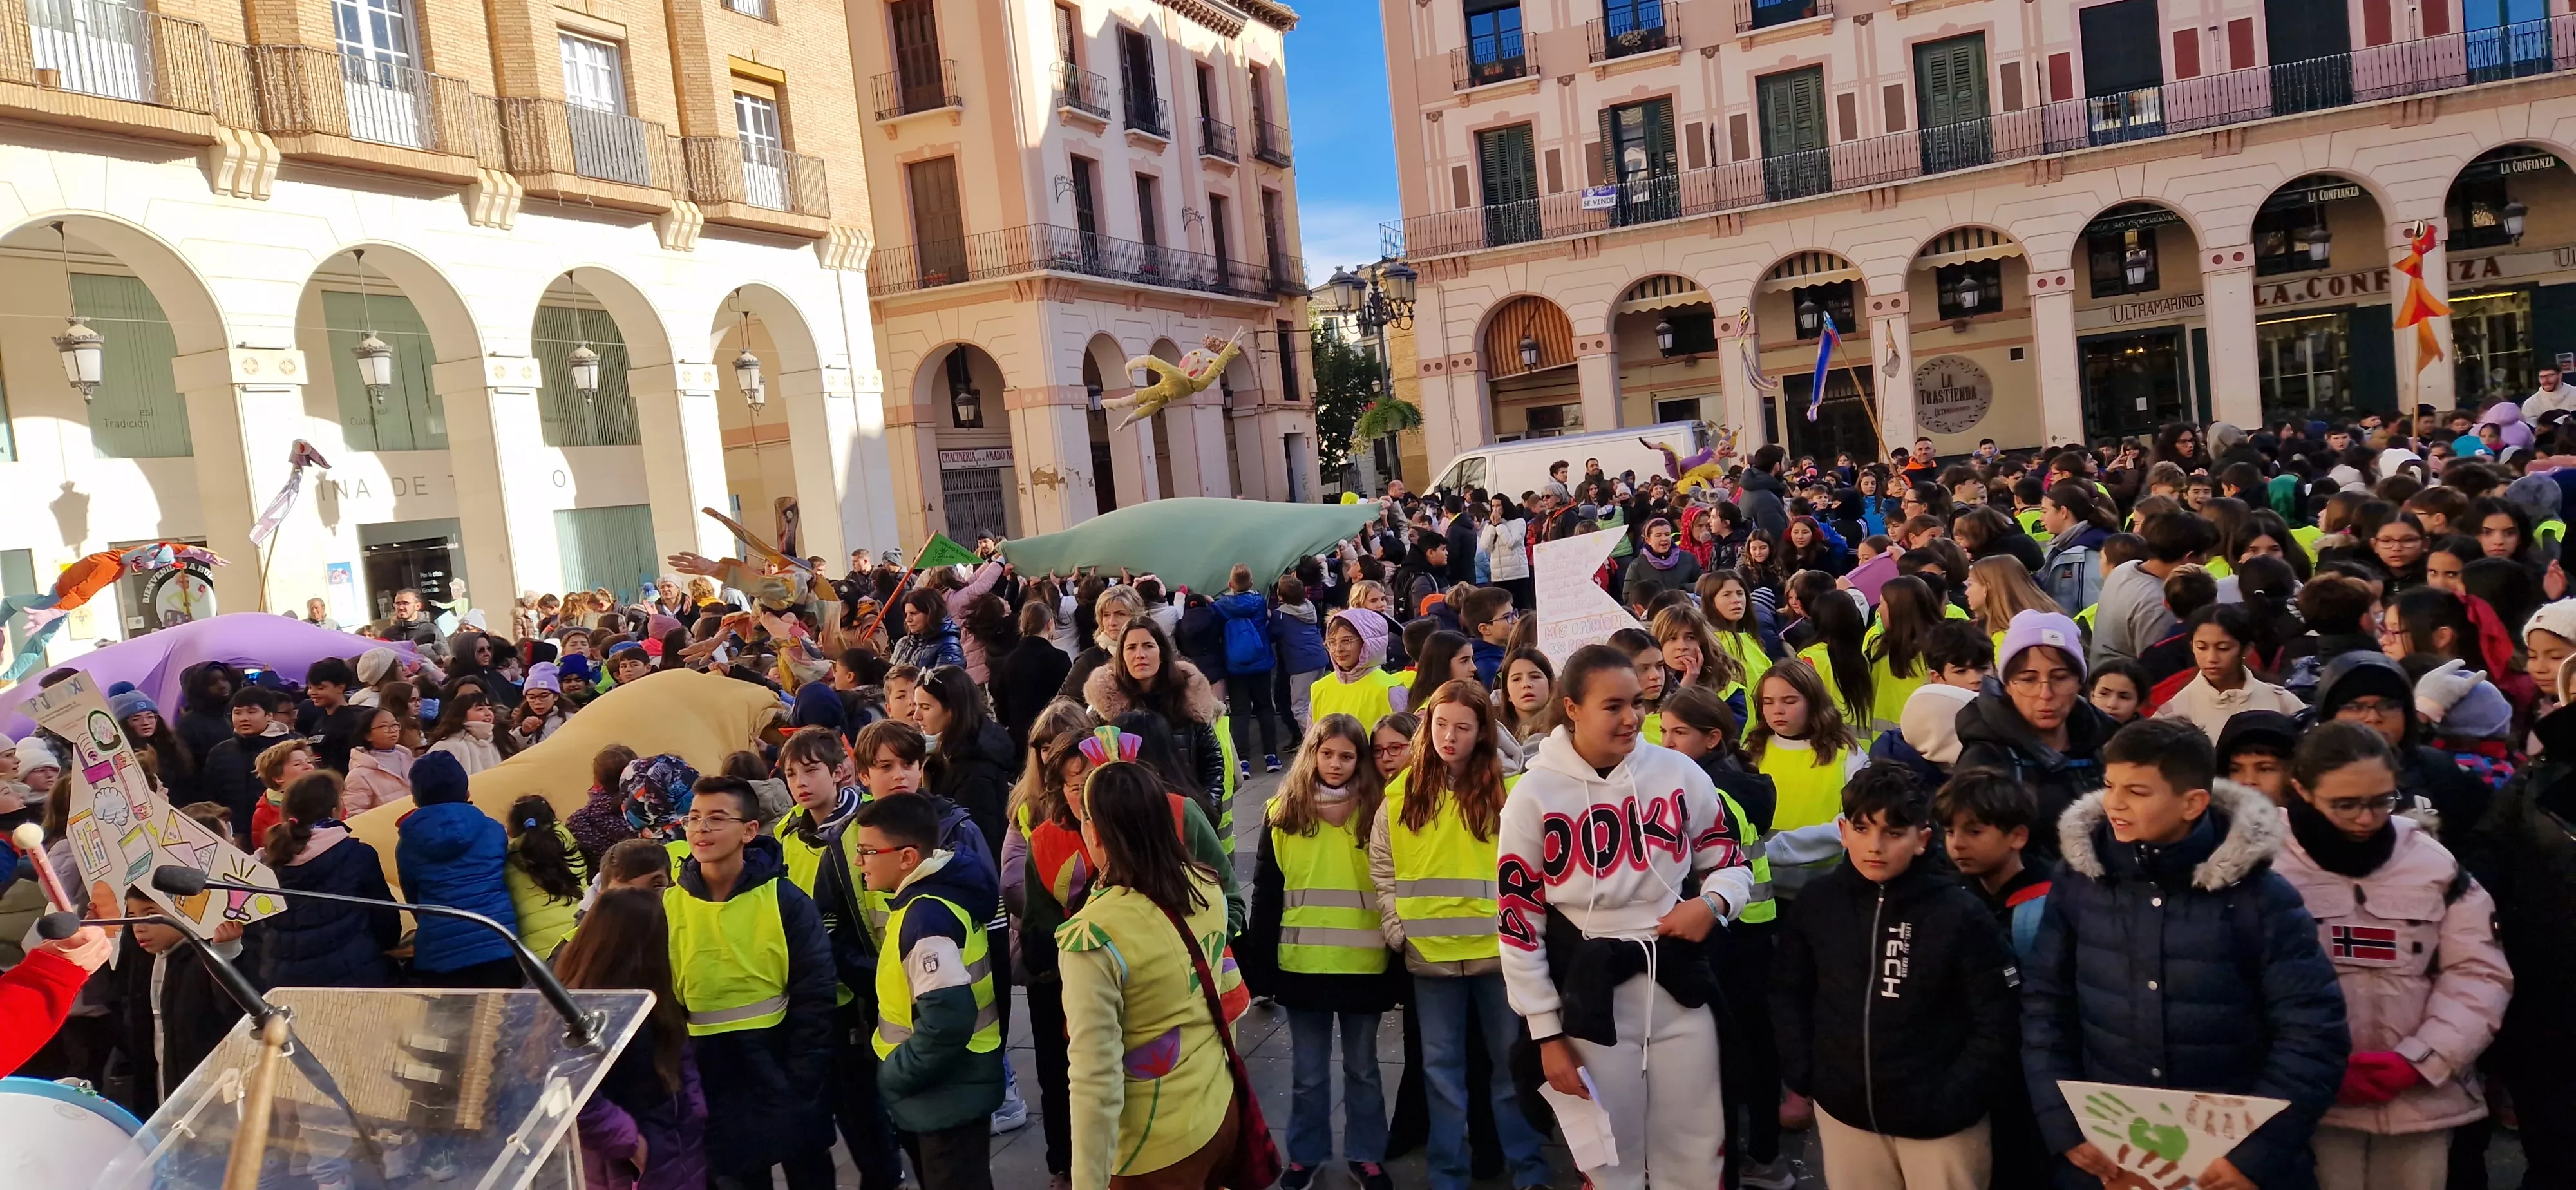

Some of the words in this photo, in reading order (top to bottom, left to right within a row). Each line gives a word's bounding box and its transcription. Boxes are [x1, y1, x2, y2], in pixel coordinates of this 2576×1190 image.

[2500, 162, 2510, 175] LA
[2512, 156, 2555, 173] CONFIANZA
[1593, 196, 1615, 206] VENDE
[2319, 185, 2360, 202] CONFIANZA
[2113, 294, 2204, 323] ULTRAMARINOS
[1941, 373, 1953, 388] LA
[1919, 386, 1977, 405] TRASTIENDA
[985, 450, 1005, 462] AMADO
[392, 475, 429, 498] DE
[925, 961, 937, 972] 88
[1881, 921, 1906, 999] TECH
